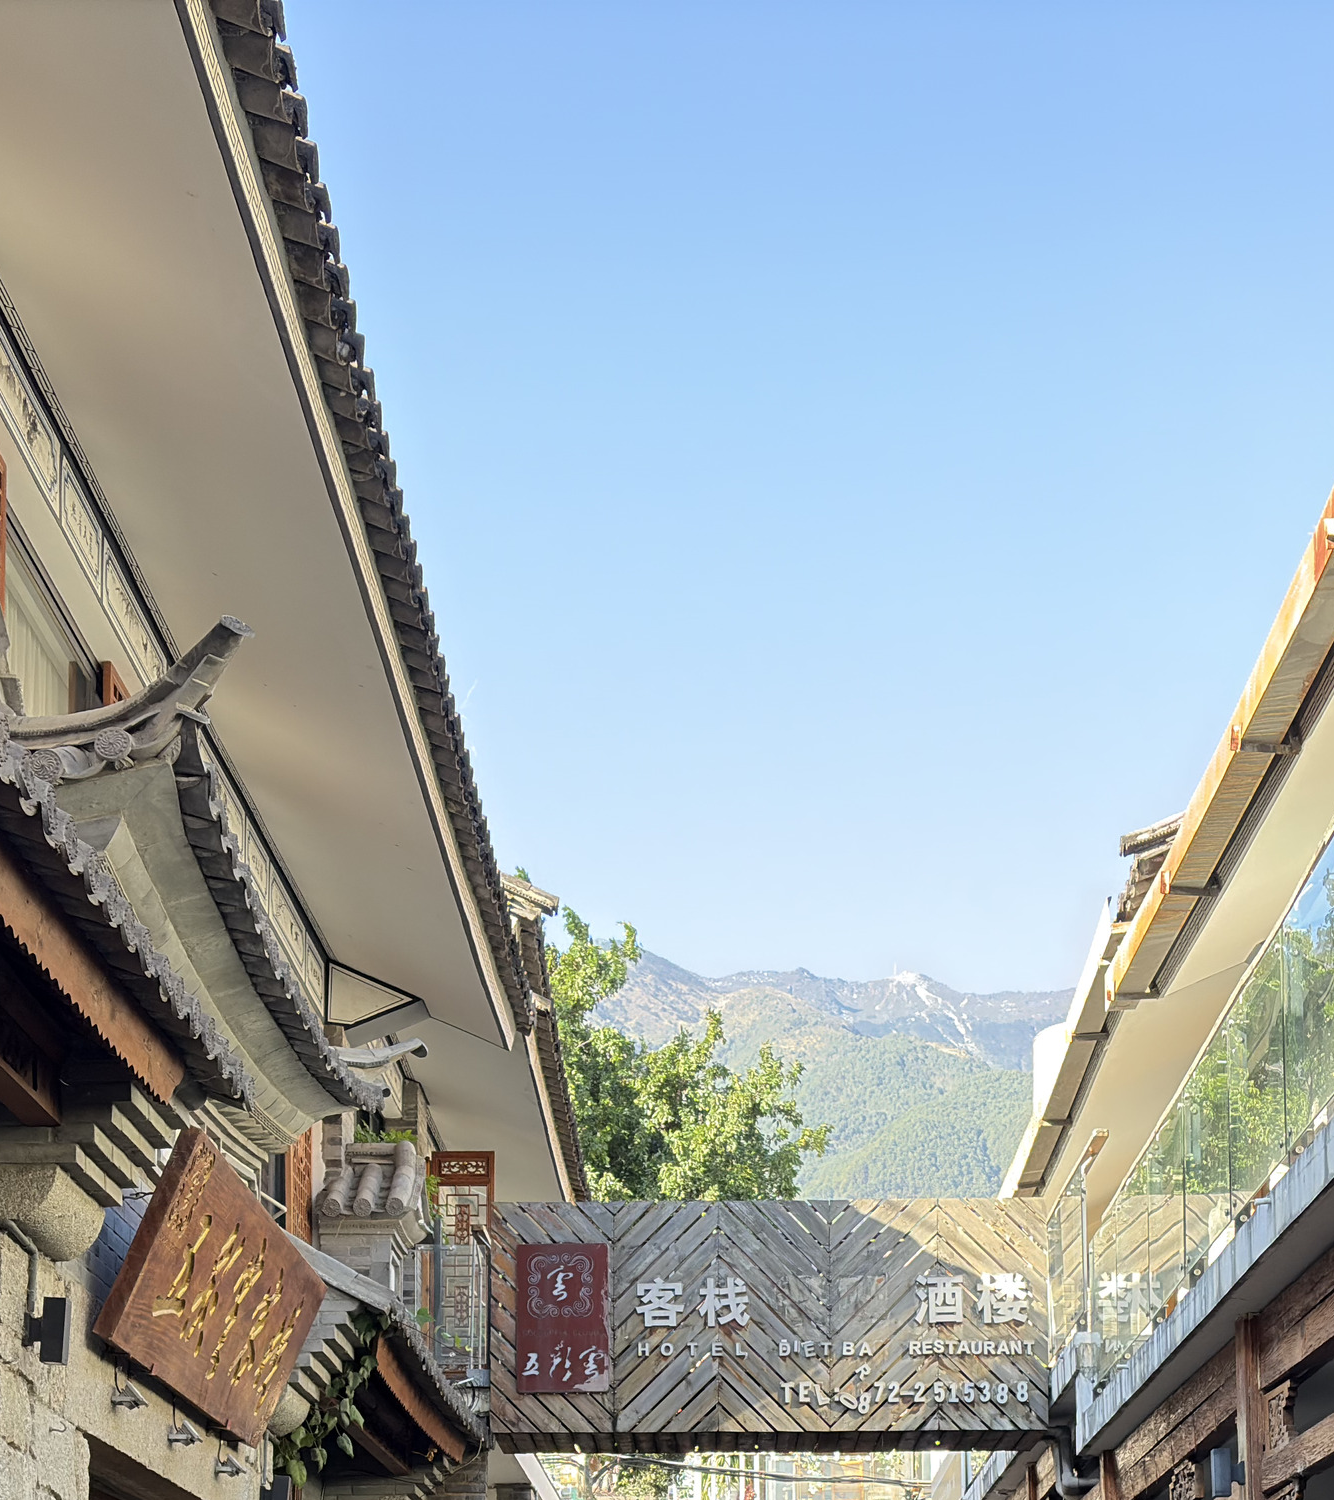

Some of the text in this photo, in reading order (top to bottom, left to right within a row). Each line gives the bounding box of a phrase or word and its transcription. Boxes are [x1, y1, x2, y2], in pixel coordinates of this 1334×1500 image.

[635, 1277, 751, 1328] 客栈
[915, 1273, 1029, 1325] 酒楼
[637, 1342, 748, 1358] HOTEL
[908, 1340, 1035, 1357] RESTAURANT
